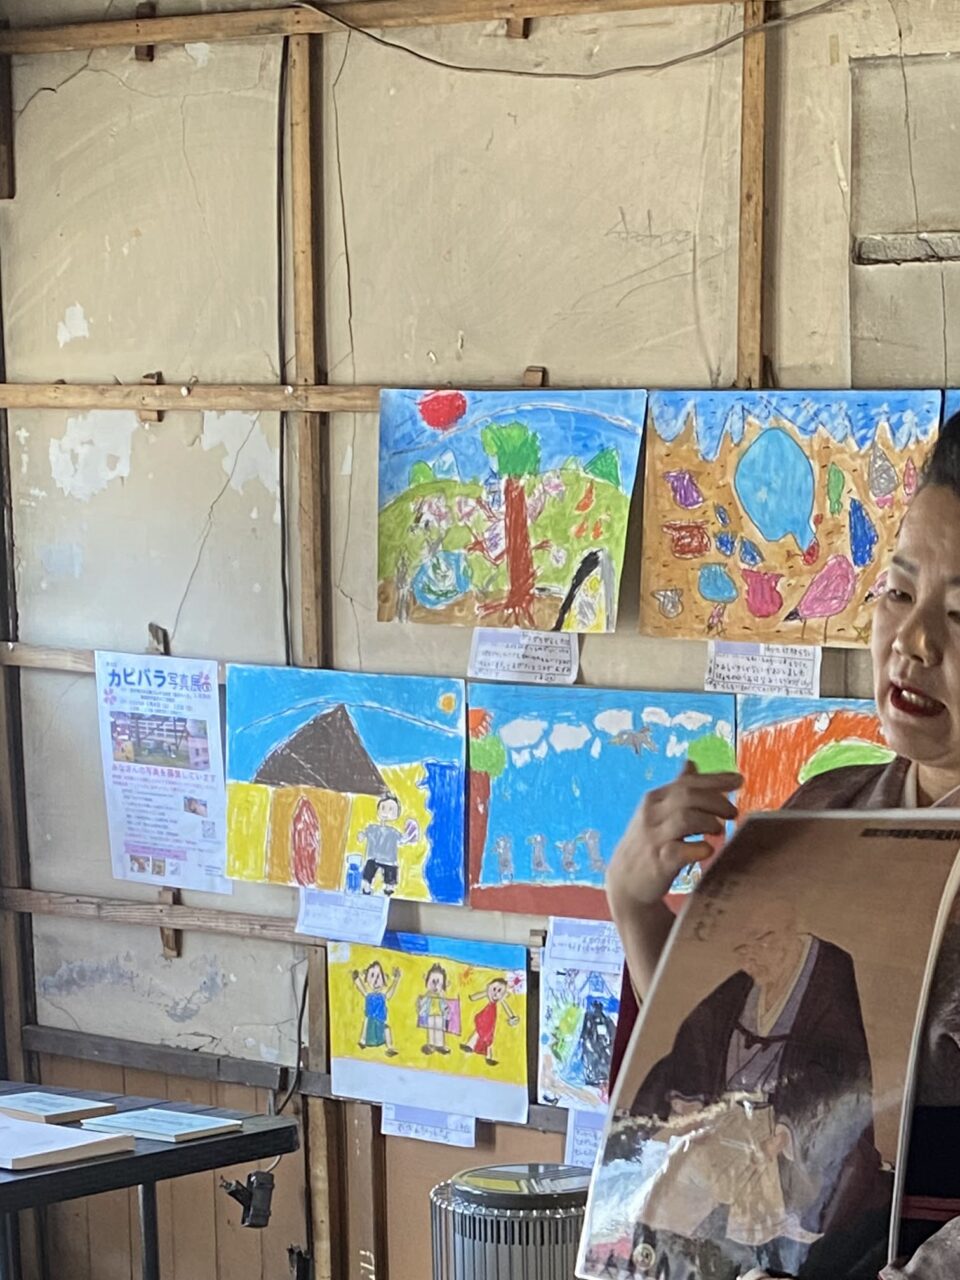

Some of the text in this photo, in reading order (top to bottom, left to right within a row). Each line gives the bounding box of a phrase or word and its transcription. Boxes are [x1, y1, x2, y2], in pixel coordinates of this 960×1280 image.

[108, 668, 202, 692] カピバラ写真展
